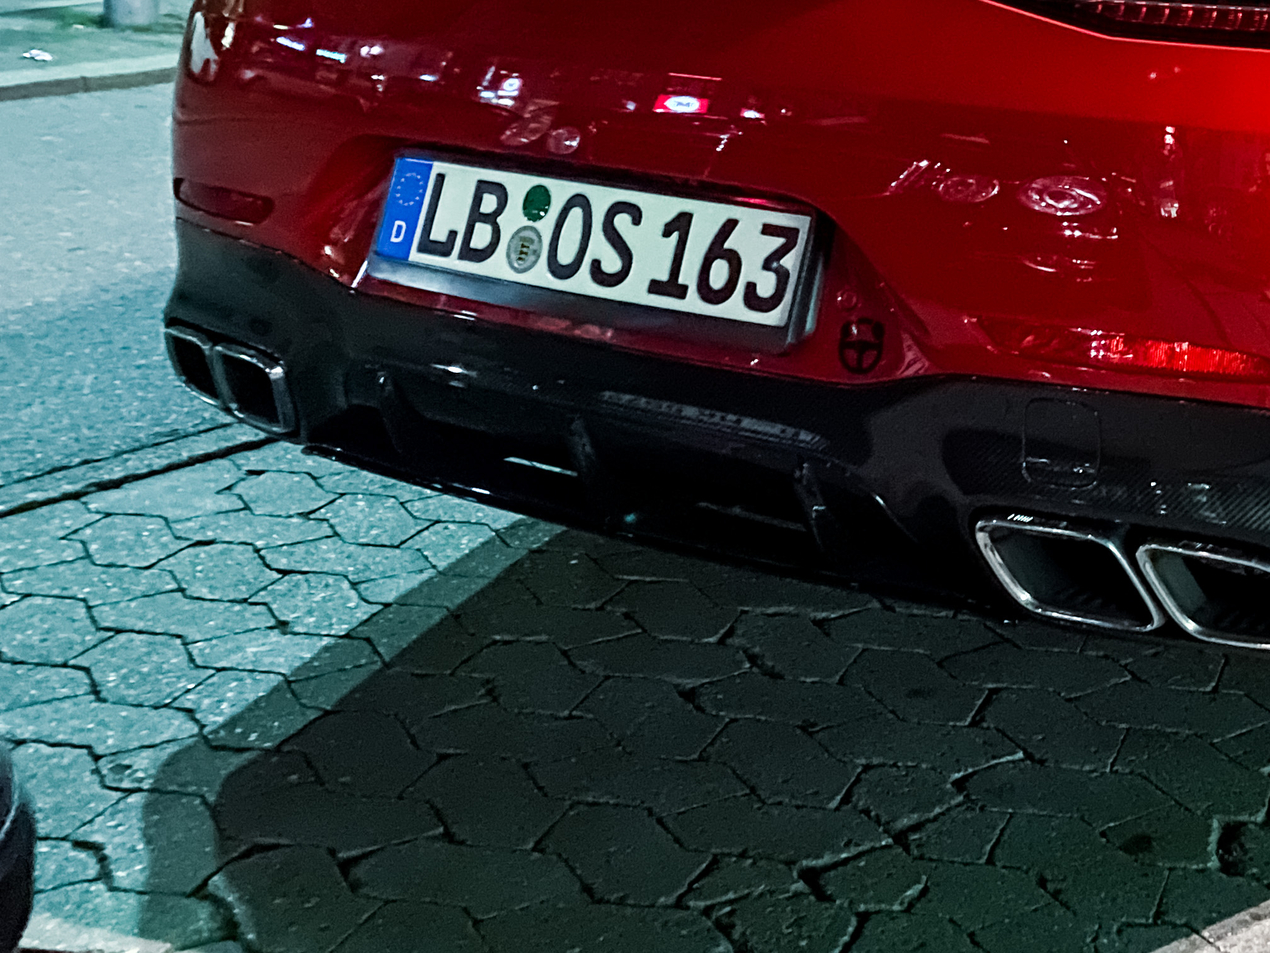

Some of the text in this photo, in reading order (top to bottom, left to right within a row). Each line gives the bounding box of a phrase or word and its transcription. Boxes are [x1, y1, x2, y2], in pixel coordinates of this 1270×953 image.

[389, 220, 406, 243] D
[415, 172, 801, 314] LB OS 163
